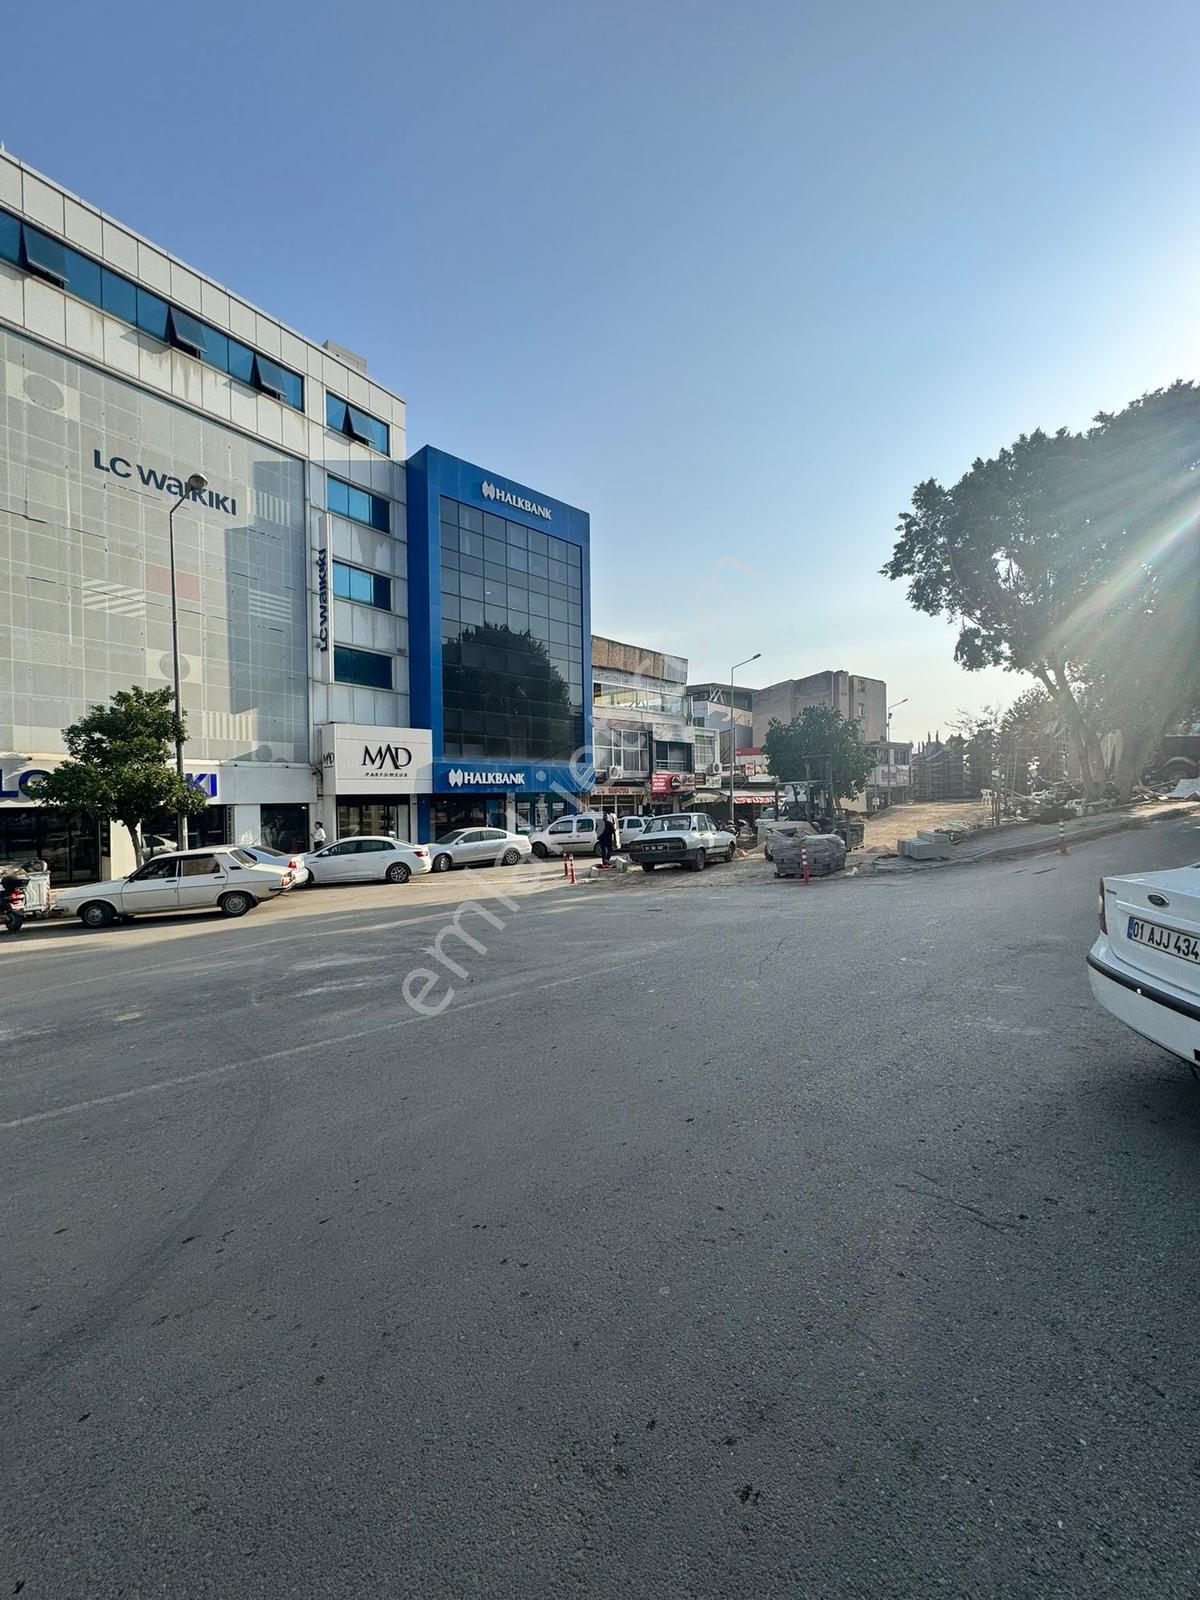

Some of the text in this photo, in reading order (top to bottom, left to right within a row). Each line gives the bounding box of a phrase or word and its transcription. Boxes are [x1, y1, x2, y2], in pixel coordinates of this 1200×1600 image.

[94, 449, 131, 478] LC
[496, 488, 552, 520] HALKBANK
[320, 627, 328, 653] LC
[361, 744, 412, 770] MAD
[464, 772, 525, 784] HALKBANK
[1132, 922, 1199, 960] 01 AJJ 434
